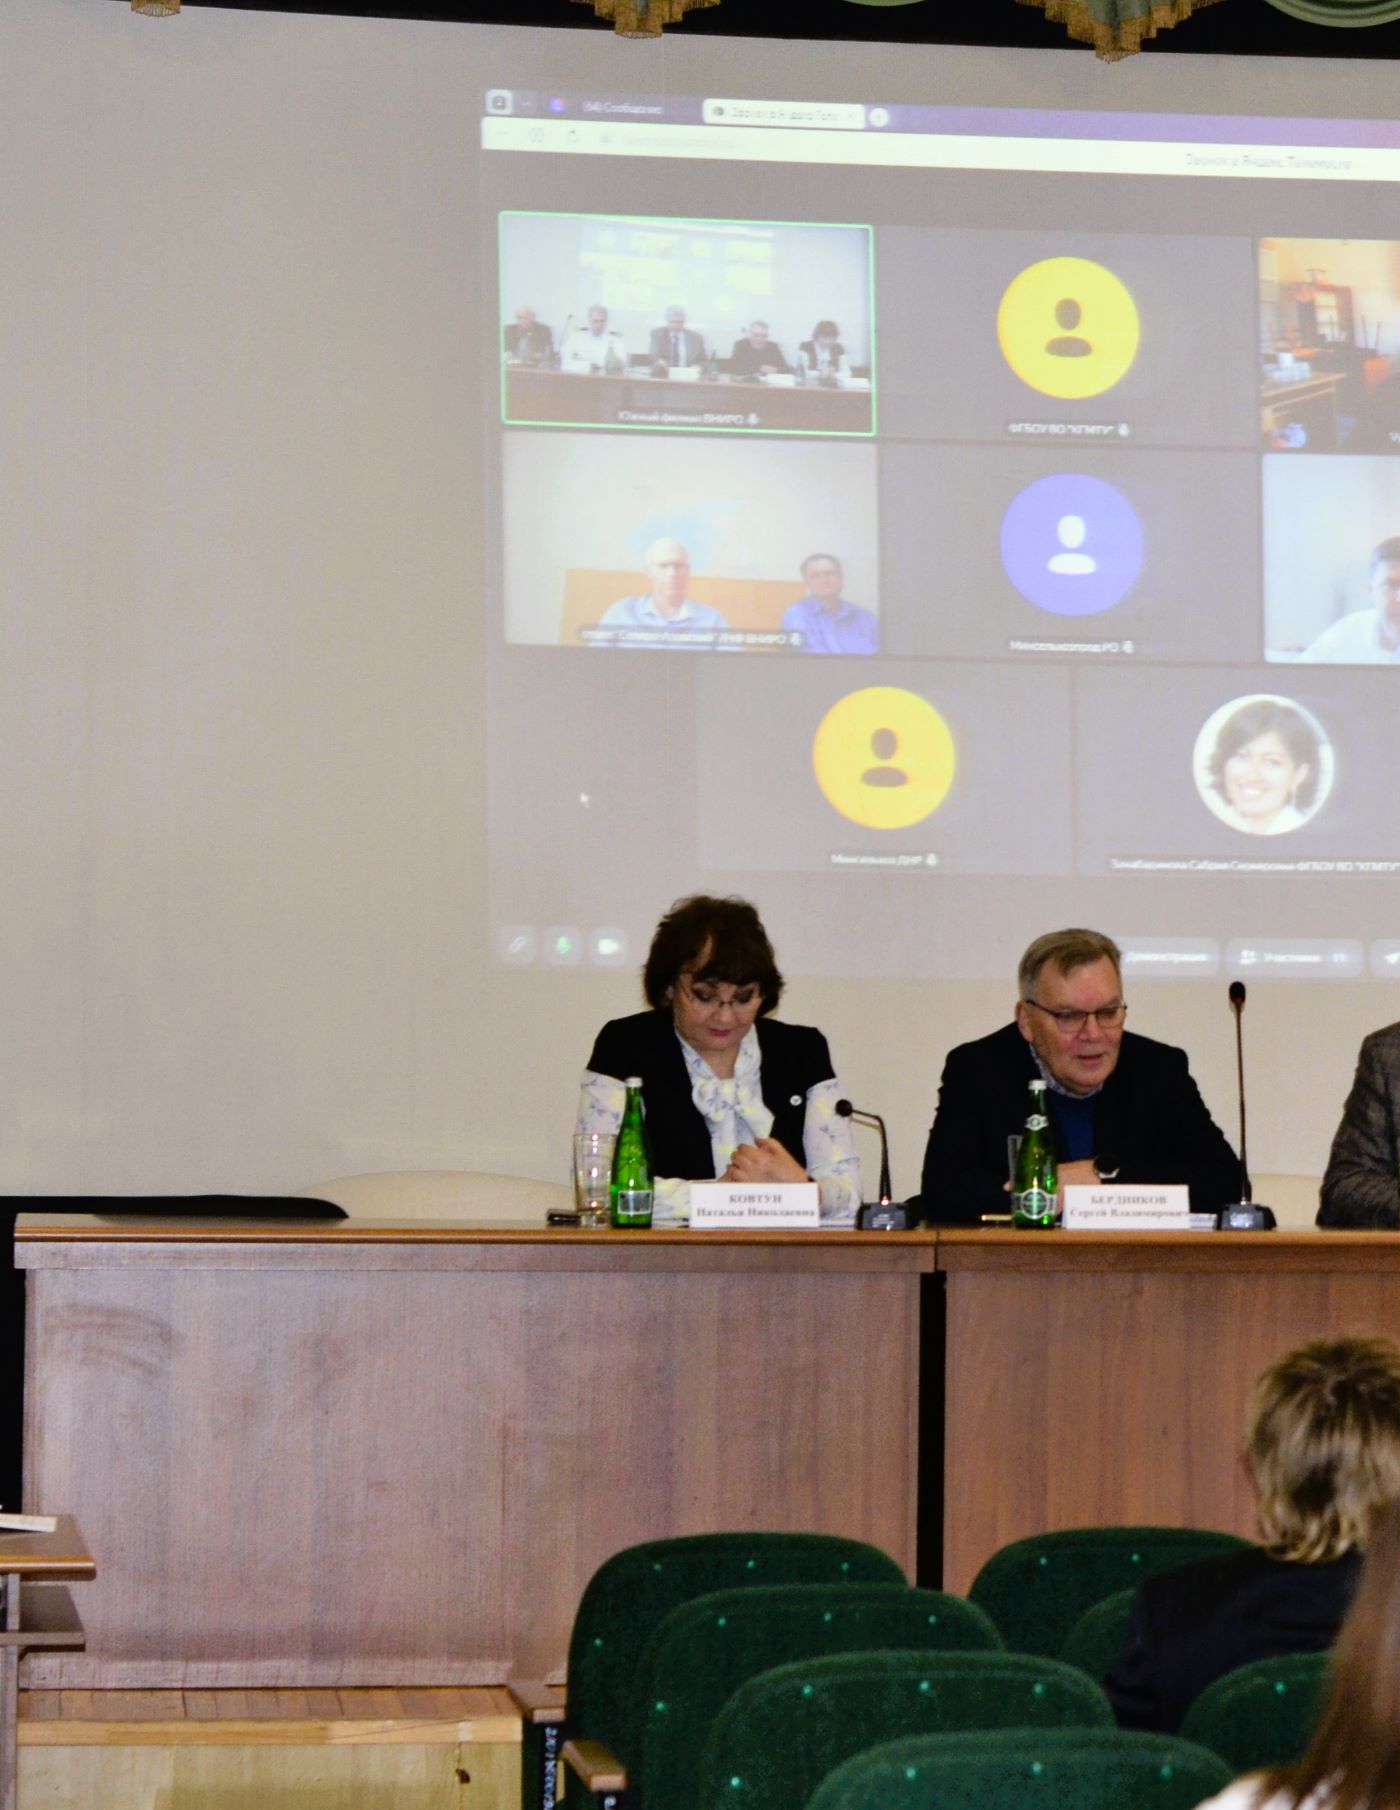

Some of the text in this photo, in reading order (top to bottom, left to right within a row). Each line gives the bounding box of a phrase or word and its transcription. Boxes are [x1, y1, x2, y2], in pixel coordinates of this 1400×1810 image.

[702, 413, 745, 425] ВНИРО
[1048, 424, 1066, 434] ВО
[729, 1194, 782, 1204] КОВТУН
[1090, 1196, 1167, 1205] БЕРДНИКОВ
[696, 1208, 816, 1217] Наталья Николаевна
[1069, 1208, 1107, 1219] Сергей
